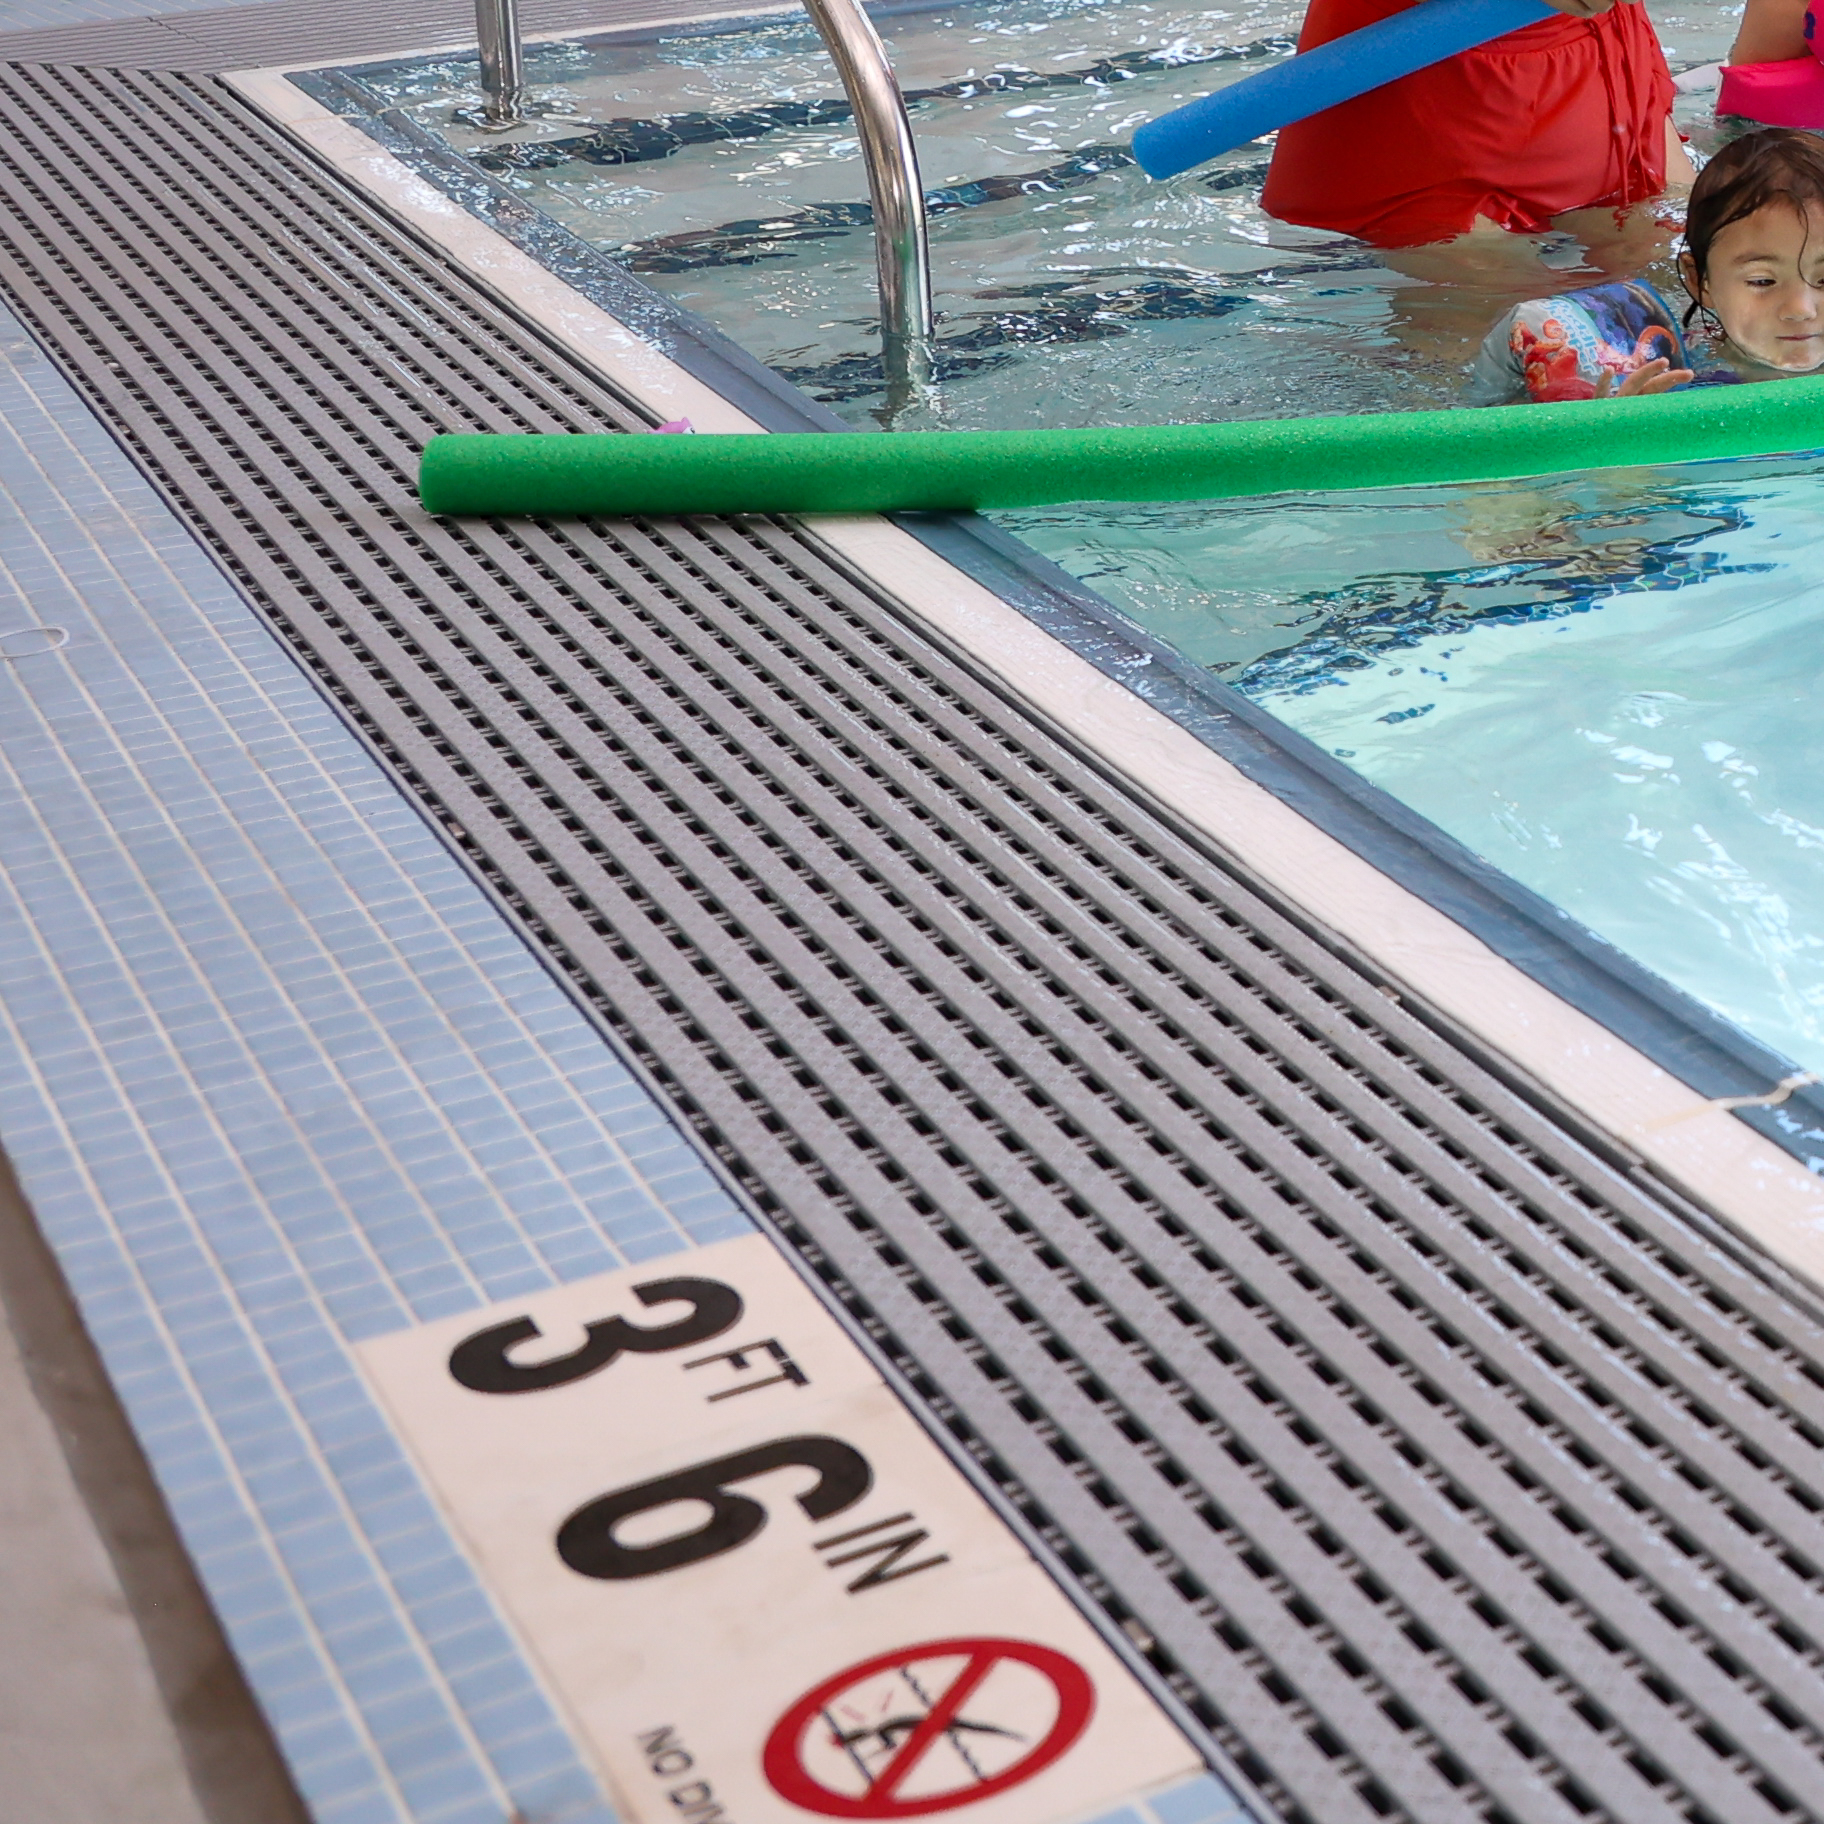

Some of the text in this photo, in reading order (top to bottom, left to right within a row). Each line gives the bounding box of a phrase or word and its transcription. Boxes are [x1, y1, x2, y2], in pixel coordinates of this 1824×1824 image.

[449, 1275, 951, 1596] 3 FT 6 IN
[637, 1725, 694, 1776] NO
